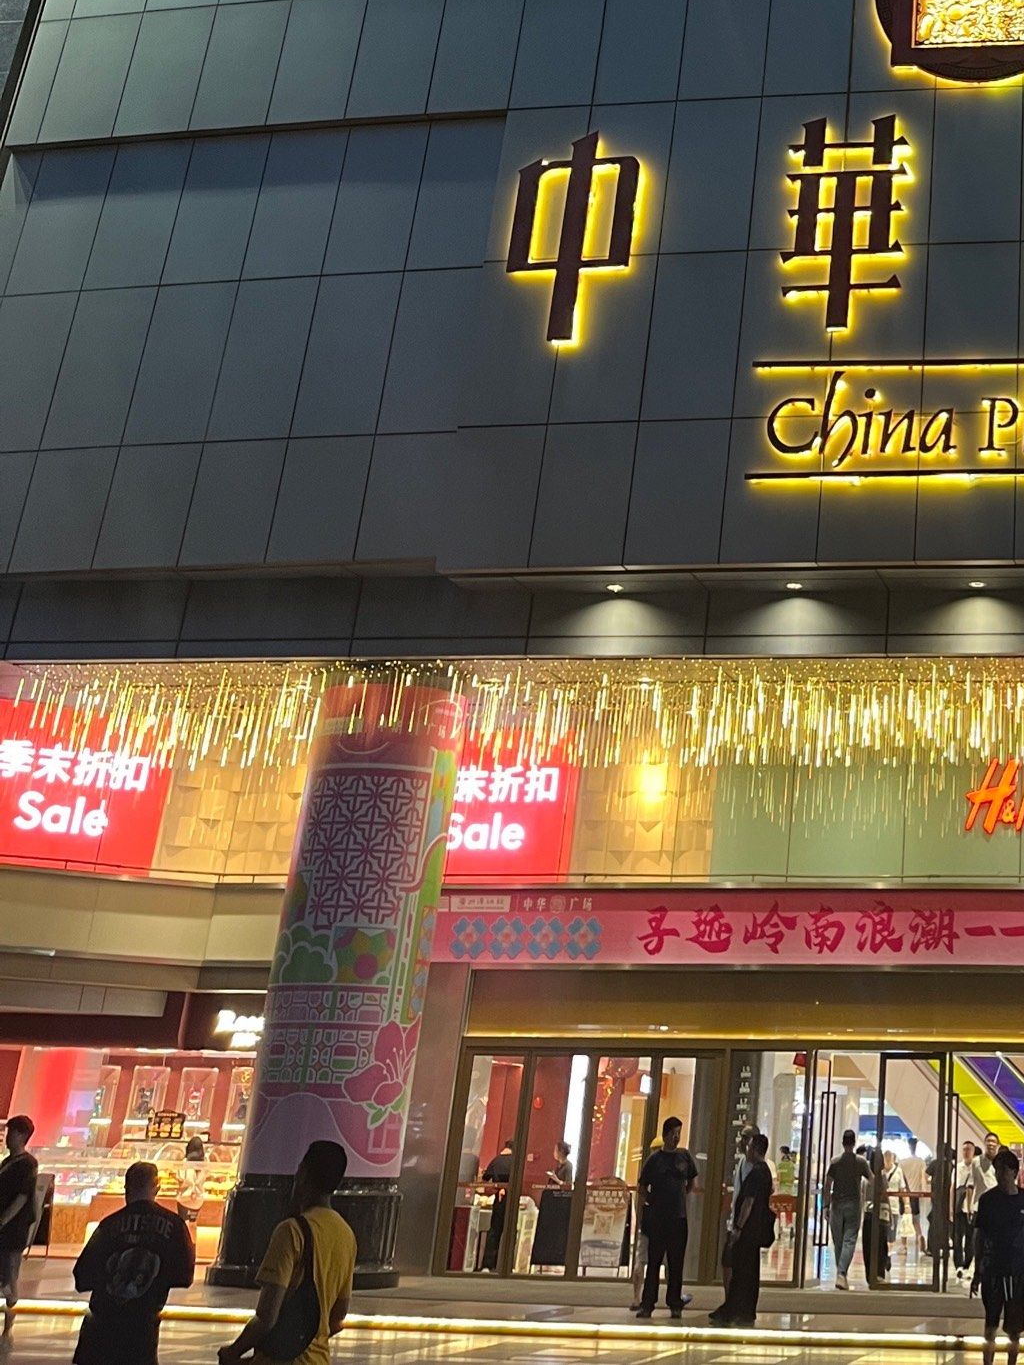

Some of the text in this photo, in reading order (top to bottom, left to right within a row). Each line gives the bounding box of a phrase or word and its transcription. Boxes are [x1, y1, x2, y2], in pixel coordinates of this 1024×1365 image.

[766, 370, 958, 468] China
[0, 739, 152, 792] 季末折扣
[13, 790, 109, 837] Sale
[446, 811, 526, 851] Sale
